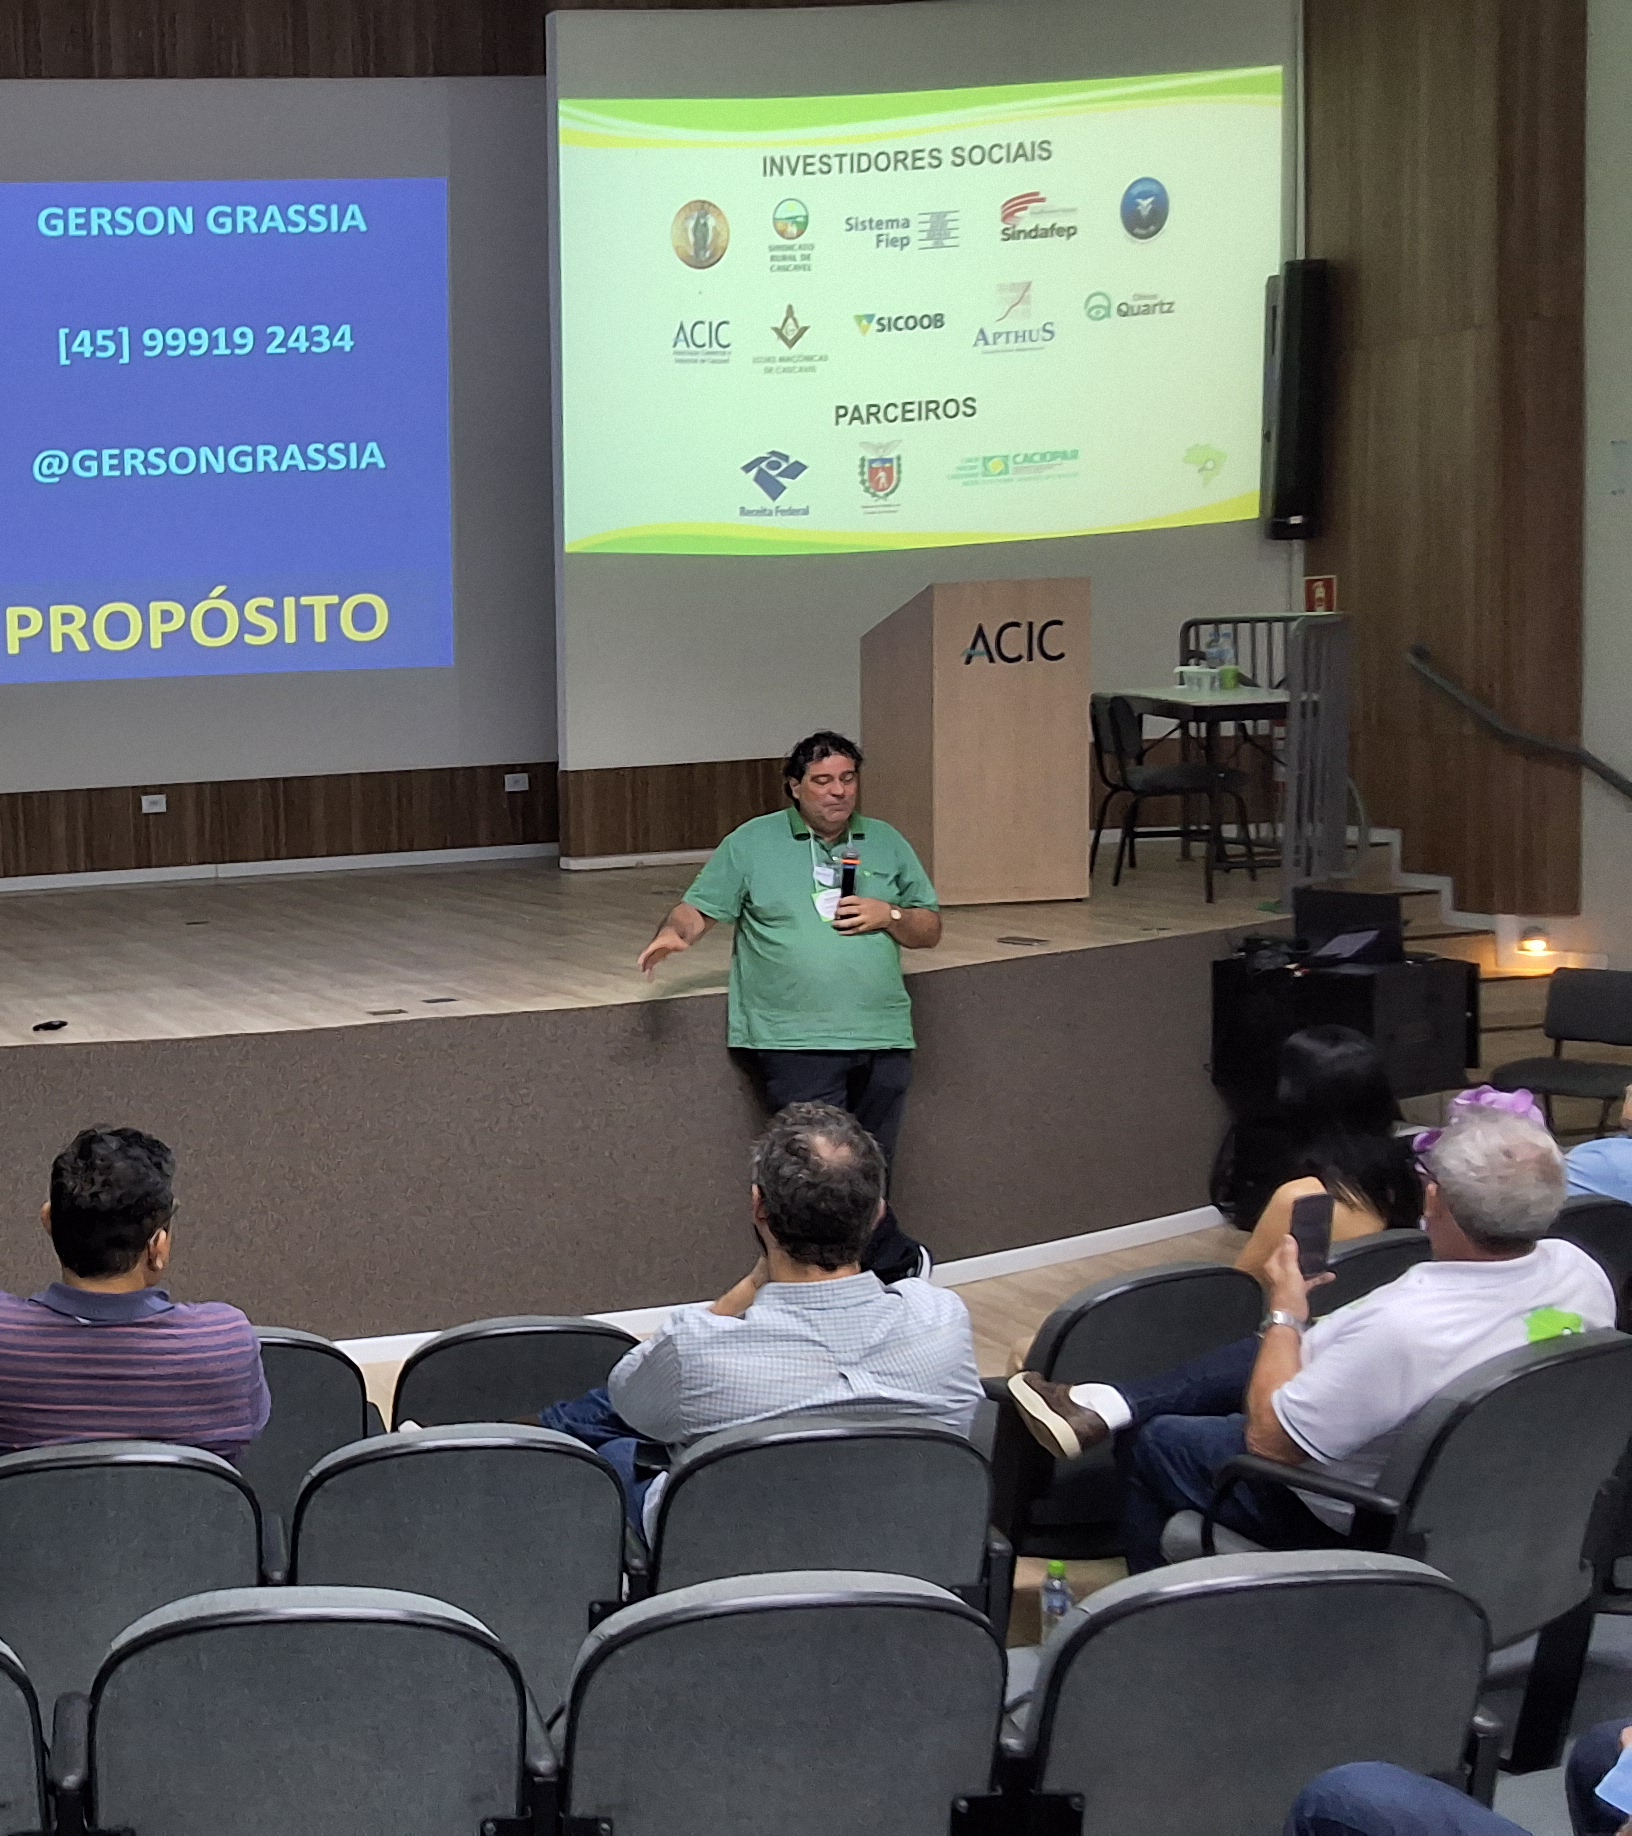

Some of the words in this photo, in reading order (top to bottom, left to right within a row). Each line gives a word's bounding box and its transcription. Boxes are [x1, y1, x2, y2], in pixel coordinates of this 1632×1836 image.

[762, 147, 943, 178] INVESTIDORES
[950, 139, 1053, 168] SOCIAIS
[37, 205, 195, 237] GERSON
[205, 203, 368, 235] GRASSIA
[844, 216, 911, 232] Sistema
[1000, 222, 1079, 242] Sindafep
[875, 233, 911, 251] Fiep
[875, 312, 946, 333] SICOOB
[1116, 299, 1176, 318] Quartz
[58, 326, 130, 366] [45]
[141, 325, 255, 357] 99919
[265, 323, 356, 355] 2434
[672, 320, 732, 349] ACIC
[972, 321, 1056, 348] APTHUS
[834, 396, 978, 427] PARCEIROS
[32, 441, 387, 484] @GERSONGRASSIA
[4, 584, 389, 656] PROPÓSITO
[963, 619, 1066, 665] ACIC
